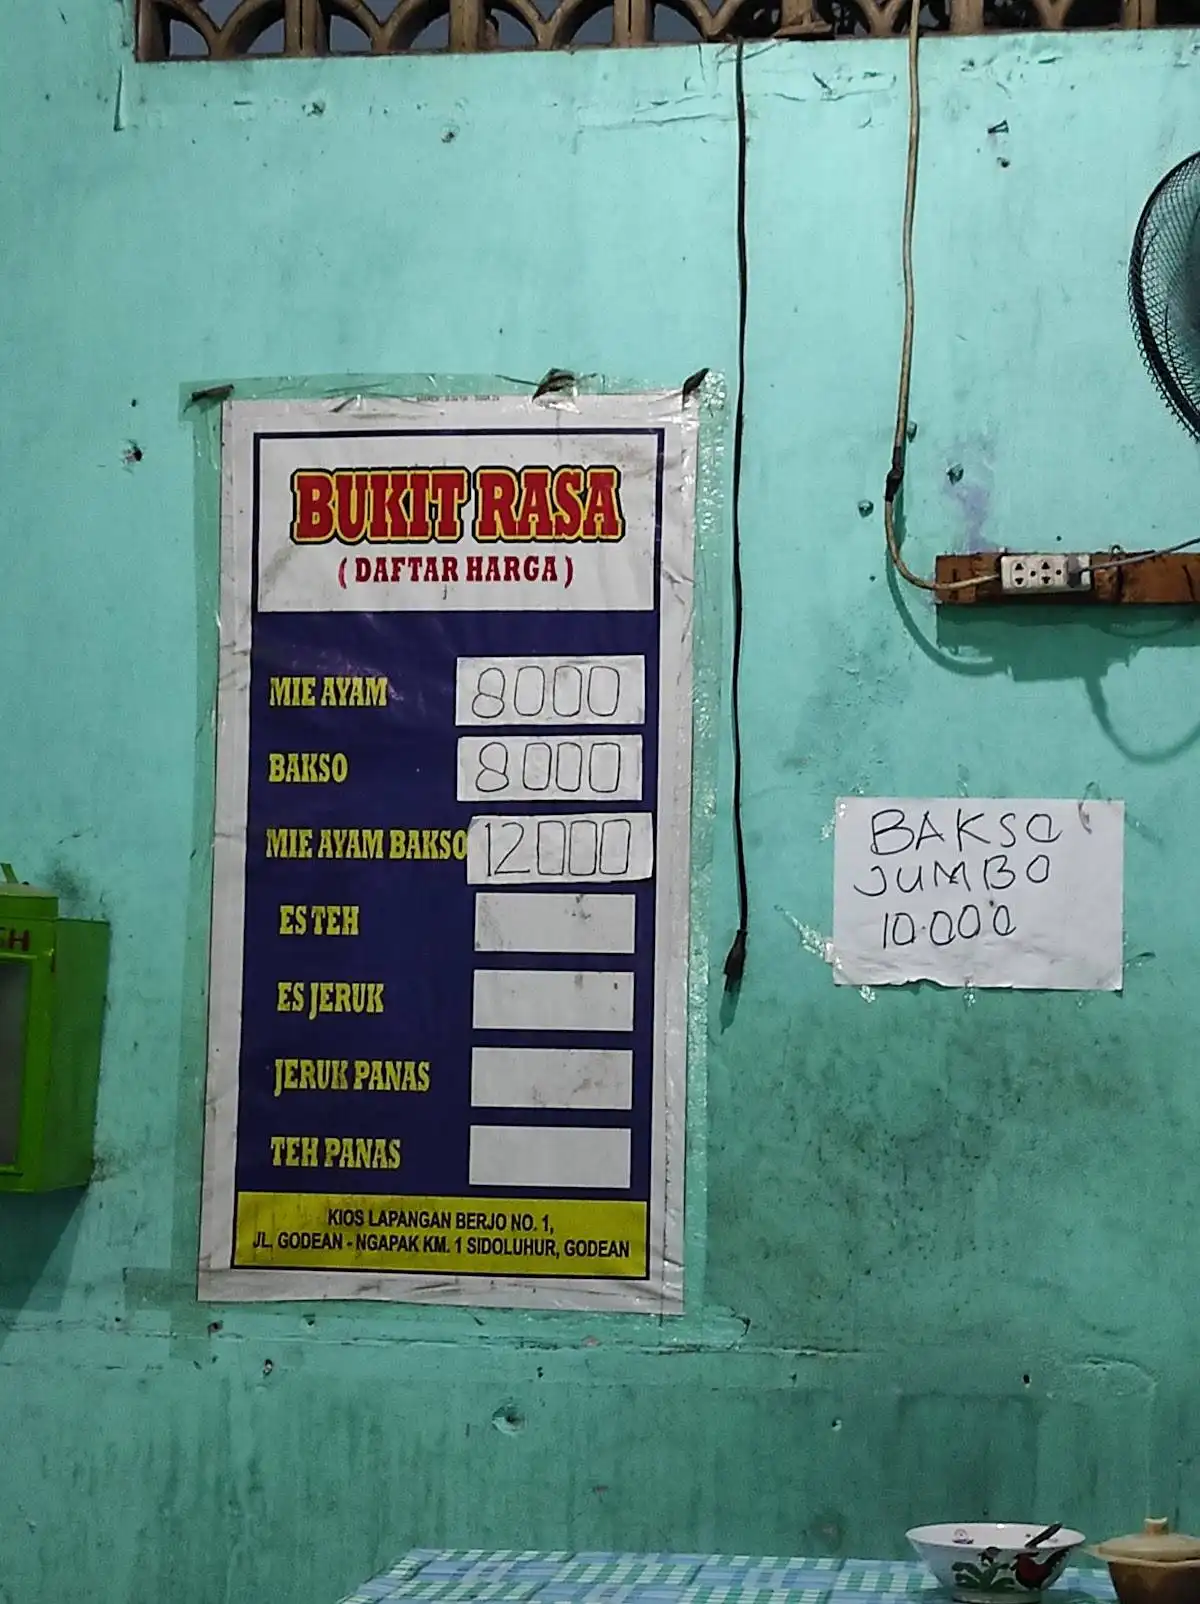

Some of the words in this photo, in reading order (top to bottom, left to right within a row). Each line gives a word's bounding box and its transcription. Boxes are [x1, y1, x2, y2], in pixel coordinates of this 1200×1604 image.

[290, 466, 471, 544] BUKIT
[472, 465, 626, 544] RASA
[270, 676, 316, 706] MIE
[321, 676, 388, 706] AYAM
[471, 665, 620, 718] 8000
[269, 753, 348, 783] BAKSO
[475, 741, 621, 793] 8000
[266, 828, 313, 858] MIE
[318, 829, 385, 859] AYAM
[389, 829, 467, 860] BAKSO
[485, 818, 632, 877] 12000
[871, 808, 1063, 855] BAKSO
[854, 854, 1050, 896] JUMBO
[279, 905, 307, 935] ES
[311, 905, 359, 935] TEH
[277, 982, 305, 1012] ES
[308, 982, 385, 1020] JERUK
[273, 1058, 348, 1096] JERUK
[353, 1060, 430, 1092] PANAS
[271, 1136, 319, 1167] TEH
[324, 1137, 401, 1169] PANAS
[328, 1208, 364, 1226] KIOS
[368, 1210, 451, 1229] LAPANGAN
[455, 1212, 507, 1231] BERJO
[511, 1214, 537, 1232] NO.
[541, 1214, 554, 1235] 1,
[277, 1232, 343, 1251] GODEAN
[356, 1233, 419, 1252] NGAPAK
[422, 1235, 450, 1253] KM.
[454, 1236, 463, 1254] 1
[467, 1237, 560, 1259] SIDOLUHUR,
[563, 1239, 630, 1258] GODEAN
